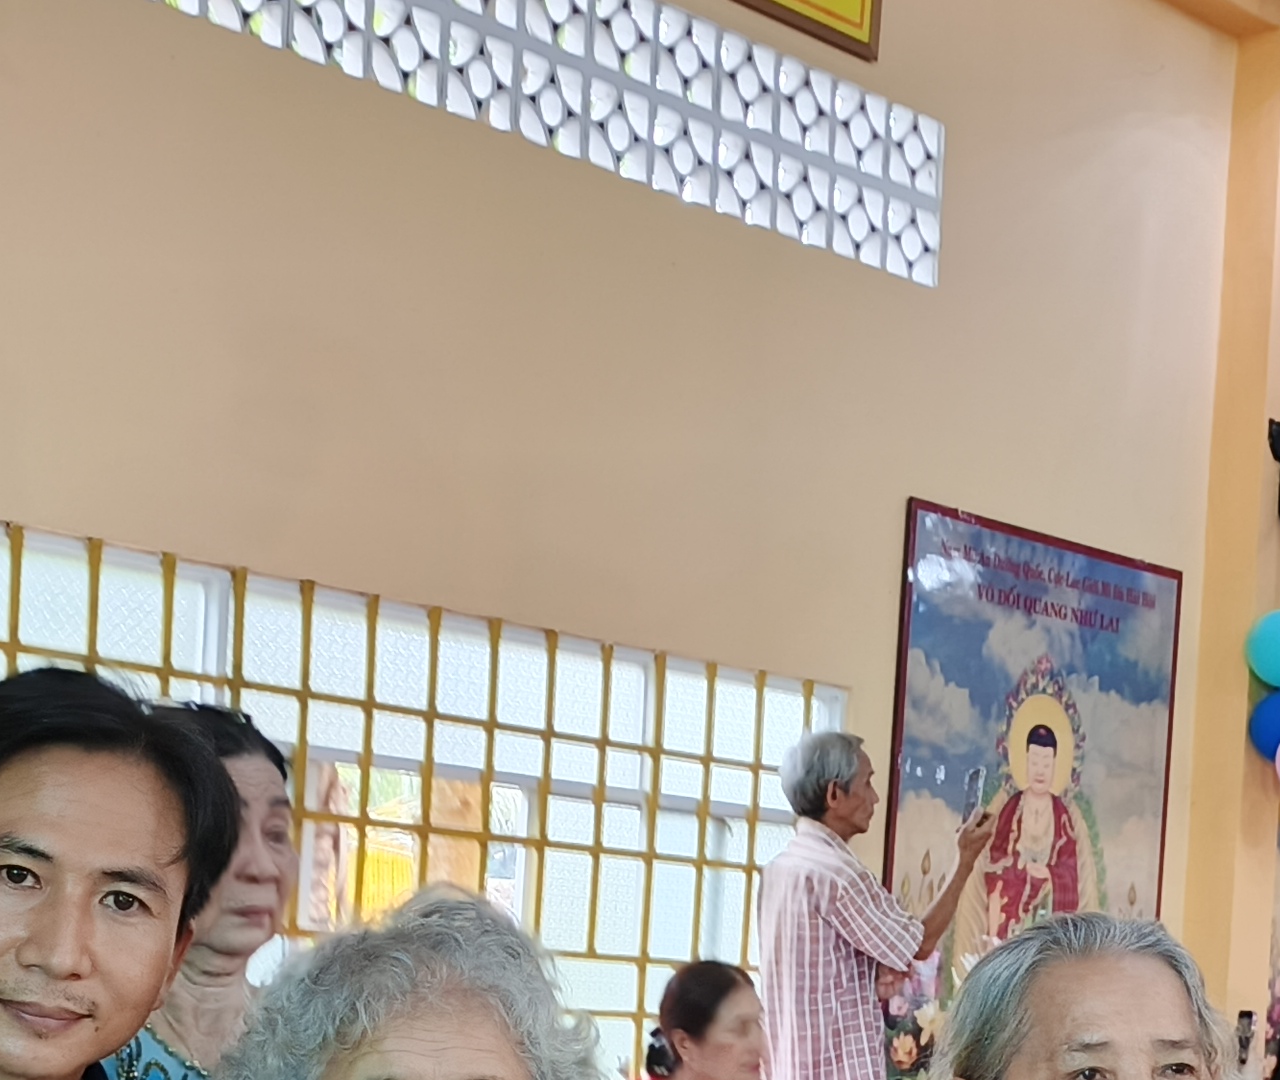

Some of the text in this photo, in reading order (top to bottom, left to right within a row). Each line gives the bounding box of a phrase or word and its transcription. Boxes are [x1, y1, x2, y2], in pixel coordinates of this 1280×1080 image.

[1023, 595, 1068, 621] QUANG
[1070, 605, 1099, 629] NHƯ
[1099, 613, 1120, 634] LAI
